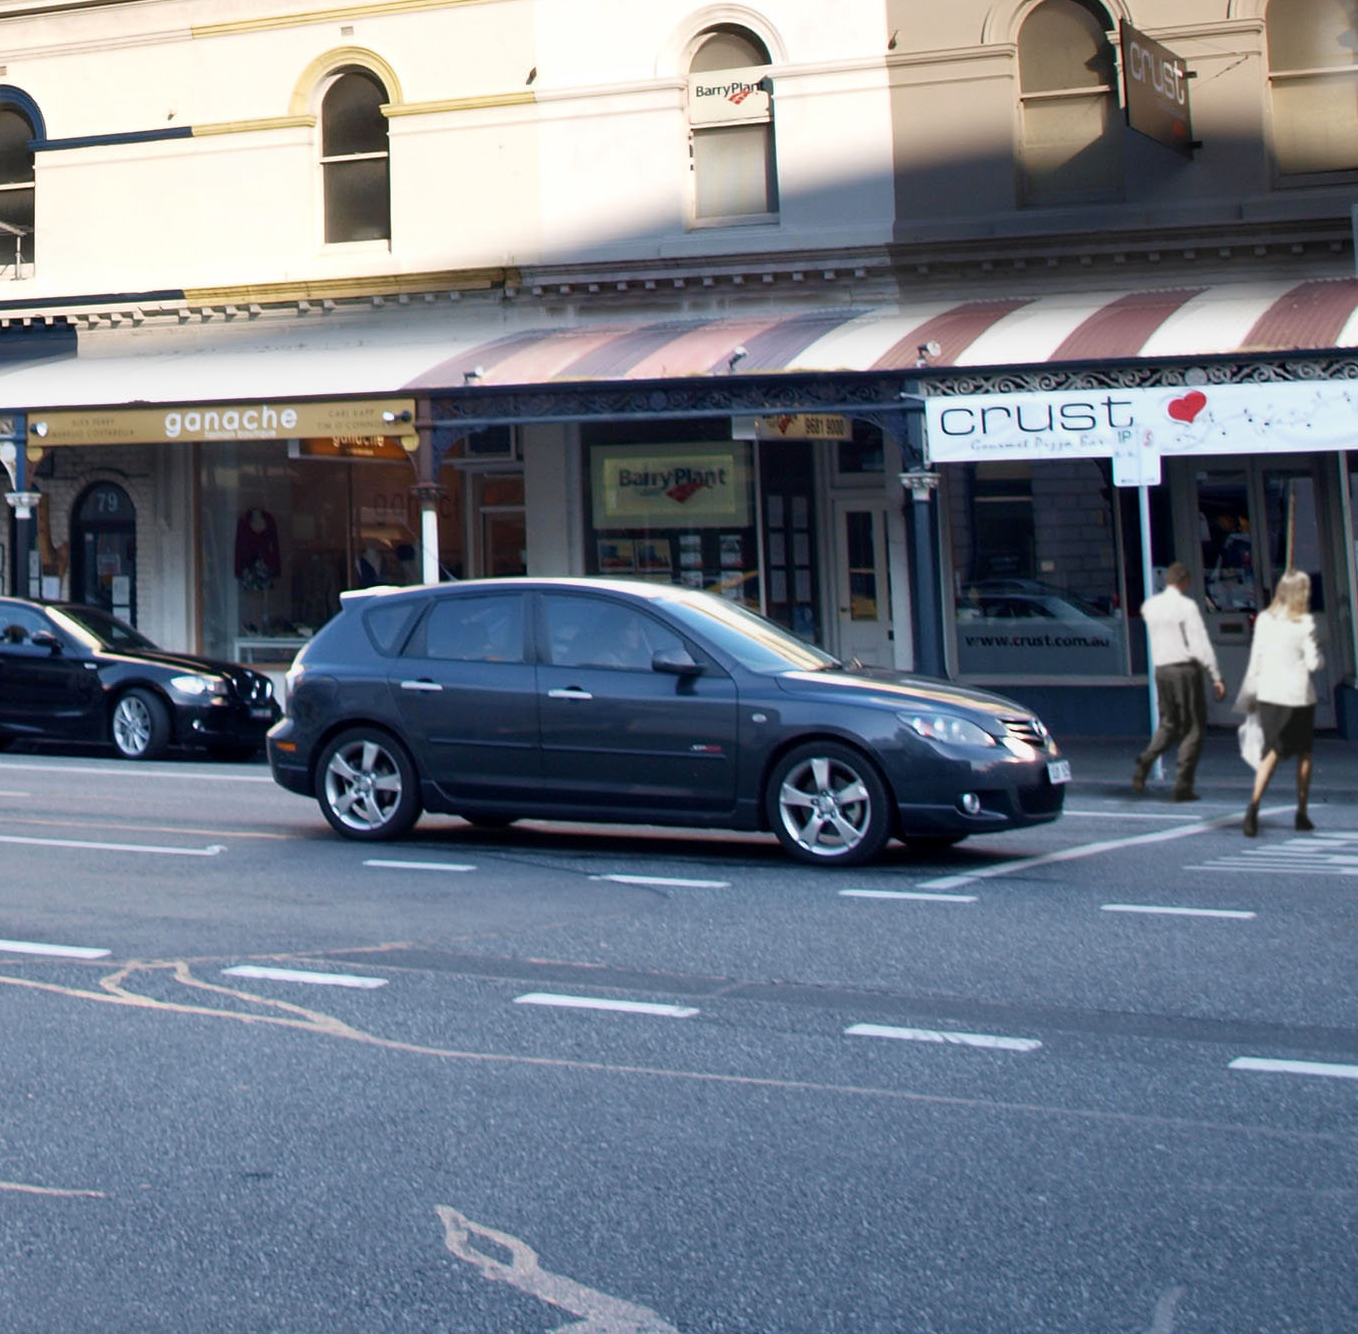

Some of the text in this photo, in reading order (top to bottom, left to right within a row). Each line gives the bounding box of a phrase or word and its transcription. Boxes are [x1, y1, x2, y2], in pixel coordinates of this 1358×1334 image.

[1129, 41, 1185, 105] crust
[164, 404, 298, 438] ganache
[940, 396, 1134, 436] crust
[96, 492, 119, 513] 79
[965, 634, 1110, 648] www.crust.com.au
